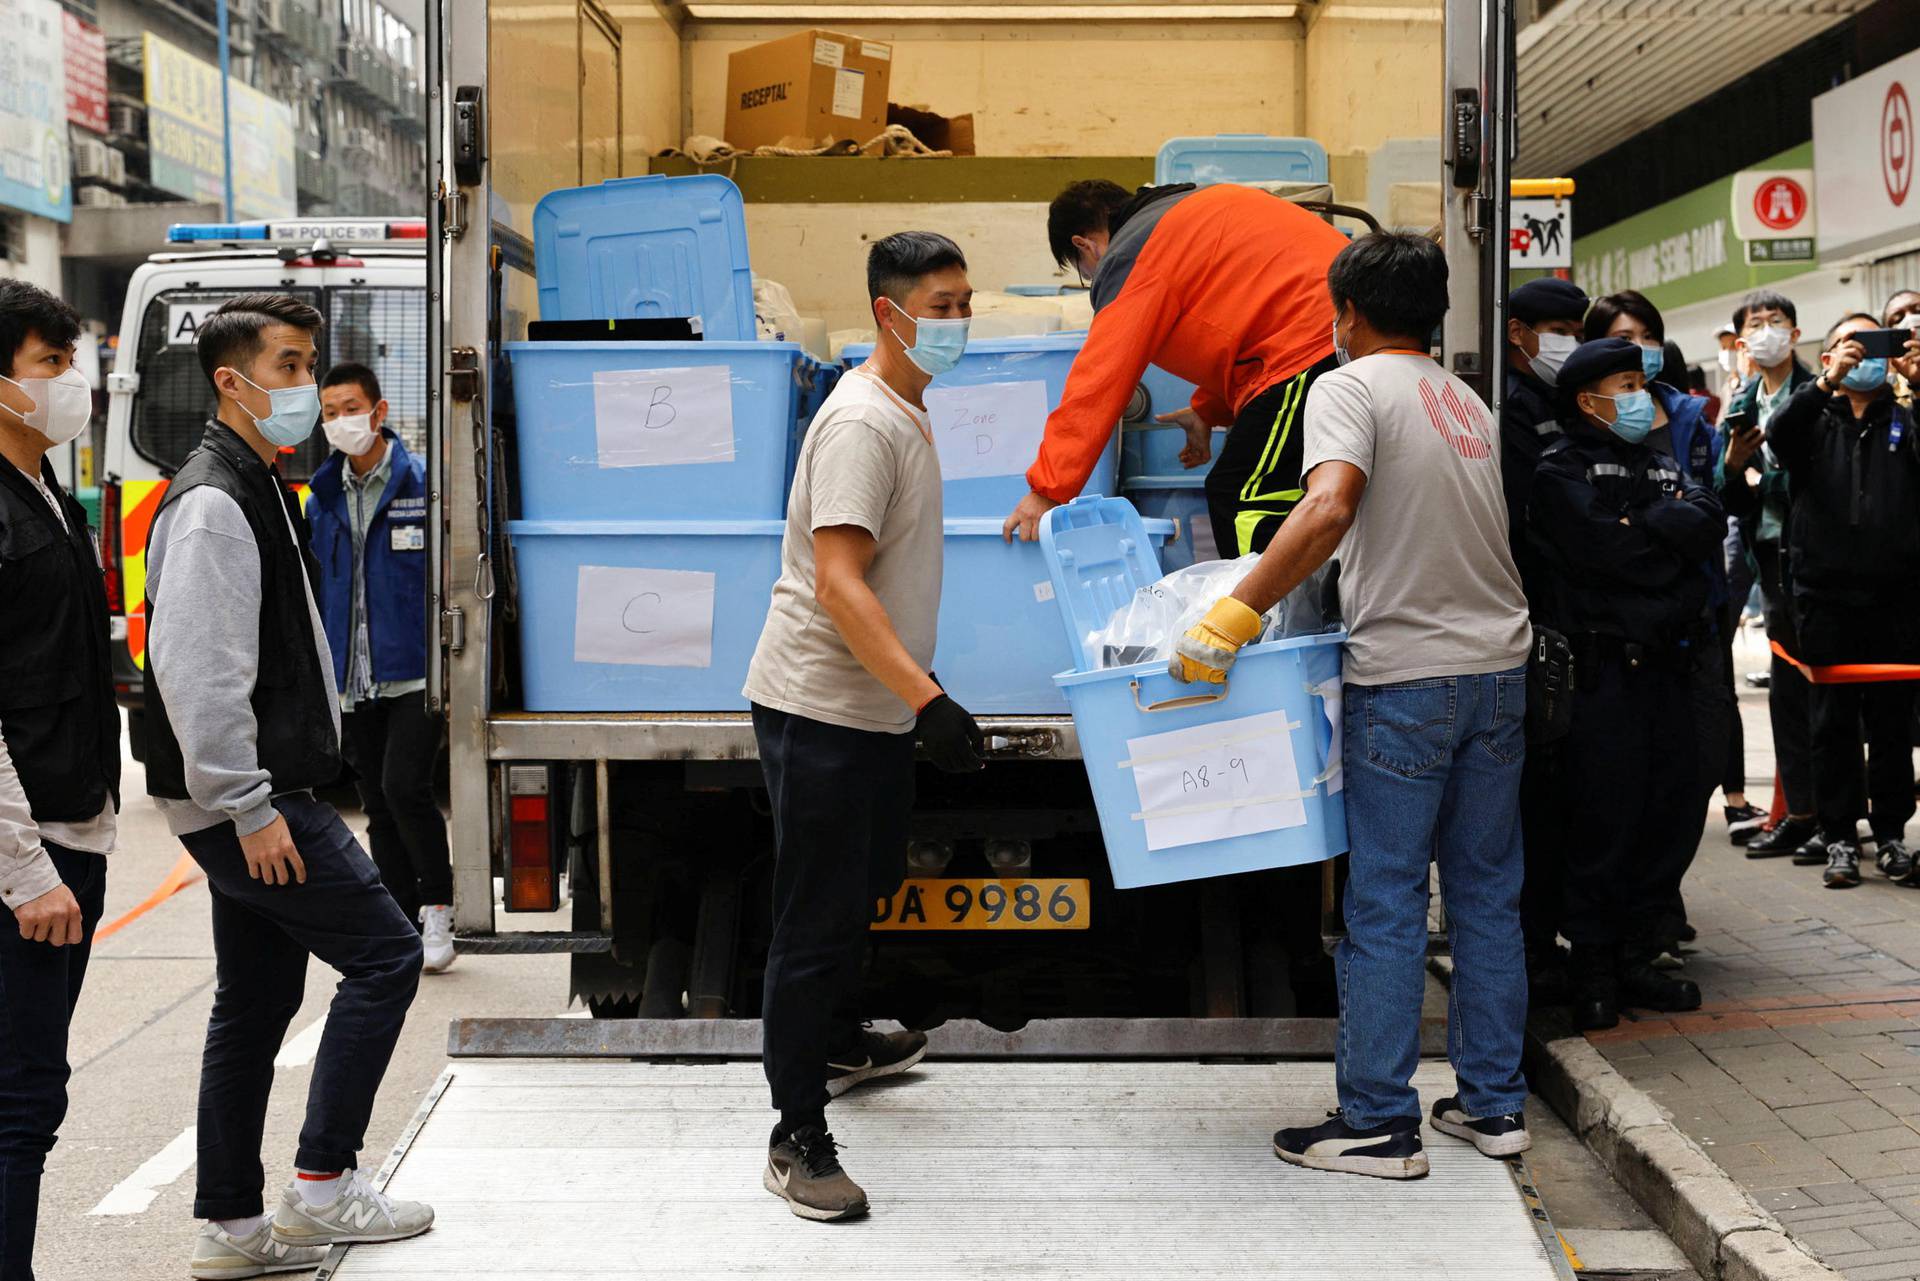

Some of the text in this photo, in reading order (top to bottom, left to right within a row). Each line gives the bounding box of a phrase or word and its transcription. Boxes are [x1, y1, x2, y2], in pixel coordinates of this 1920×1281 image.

[740, 82, 787, 110] RECEPTAL
[300, 226, 356, 239] POLICE
[644, 385, 677, 429] B
[950, 408, 998, 431] Zone
[975, 434, 994, 455] D
[622, 592, 661, 634] C
[1183, 758, 1249, 793] A8-9
[944, 884, 1077, 923] 9986
